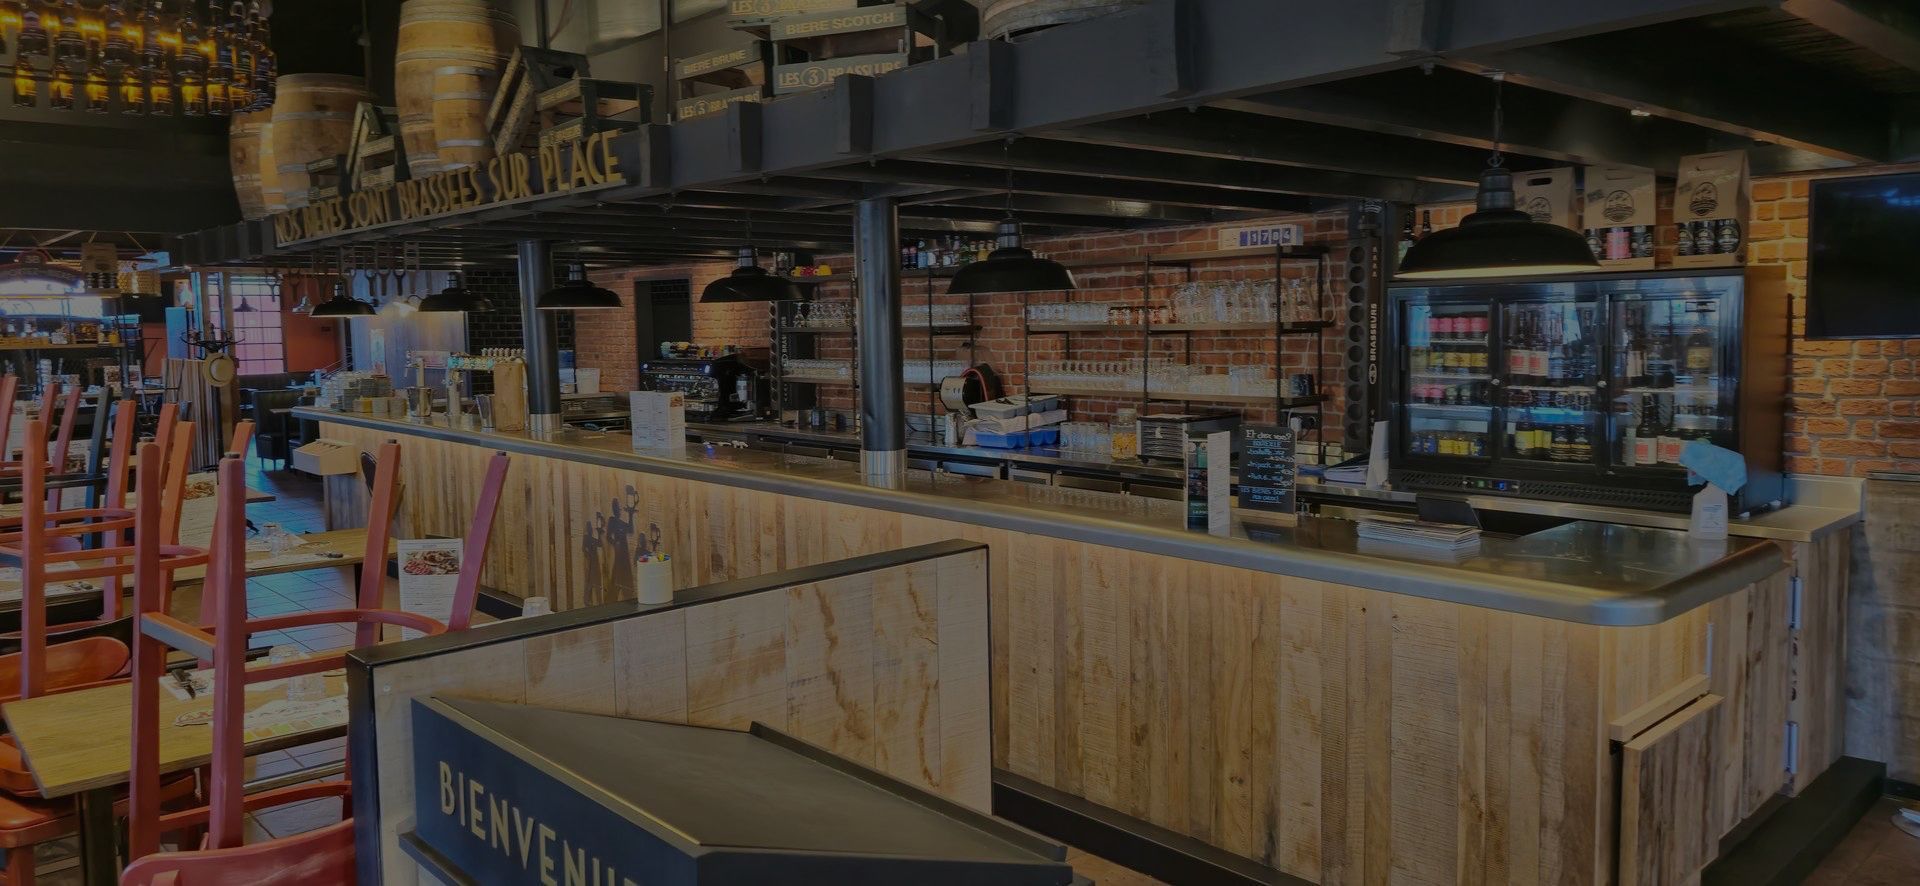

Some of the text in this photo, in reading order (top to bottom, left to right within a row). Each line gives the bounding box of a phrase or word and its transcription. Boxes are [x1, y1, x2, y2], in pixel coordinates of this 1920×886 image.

[785, 12, 895, 35] BIERE SCOTCH
[779, 72, 800, 86] LES
[348, 189, 392, 228] SONT
[488, 152, 534, 202] SUR
[540, 128, 623, 194] PLACE
[439, 760, 641, 886] BIENVEN
